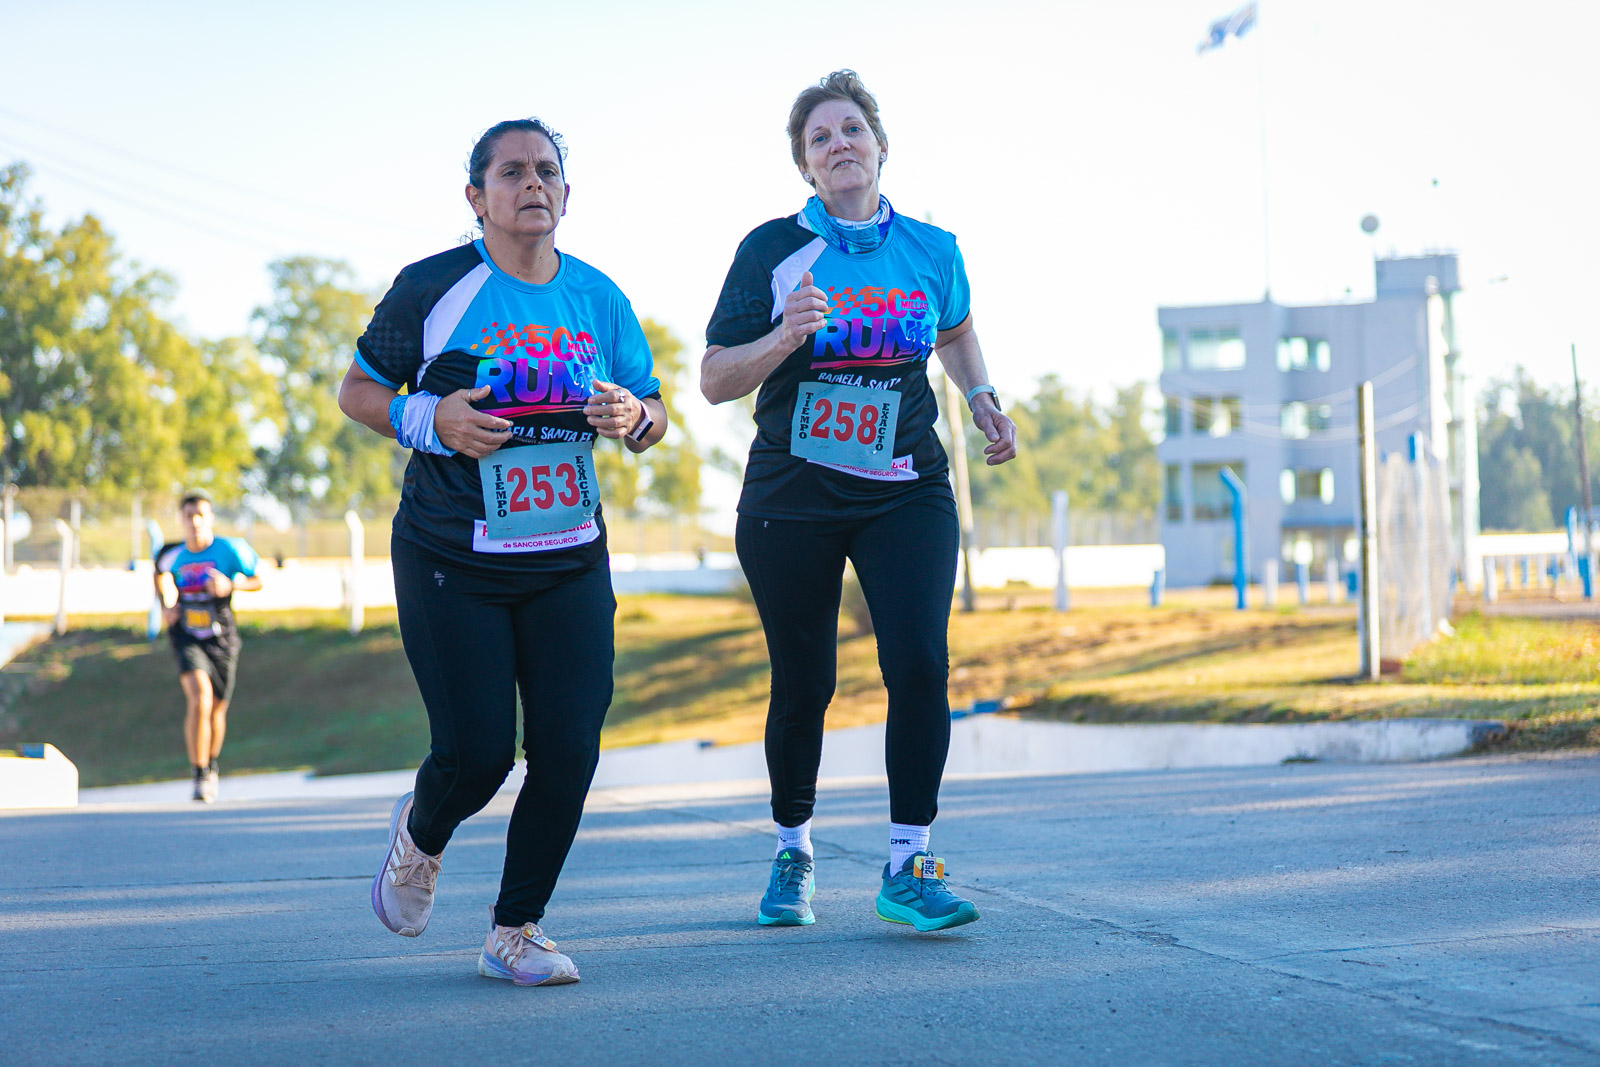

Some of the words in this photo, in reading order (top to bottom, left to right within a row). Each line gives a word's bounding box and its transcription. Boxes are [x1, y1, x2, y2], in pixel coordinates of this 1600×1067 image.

[860, 287, 927, 319] 500
[901, 301, 928, 310] MILLAS
[525, 324, 594, 366] 500
[813, 318, 919, 357] RUN
[475, 358, 588, 403] RUN
[541, 427, 578, 442] SANTA
[799, 392, 813, 439] TIEMPO
[810, 398, 879, 445] 258
[875, 403, 890, 451] EXACTO
[493, 465, 507, 518] TIEMPO
[507, 463, 580, 513] 253
[575, 456, 590, 507] EXACTO
[544, 536, 578, 546] SEGUROS
[925, 860, 934, 874] 258
